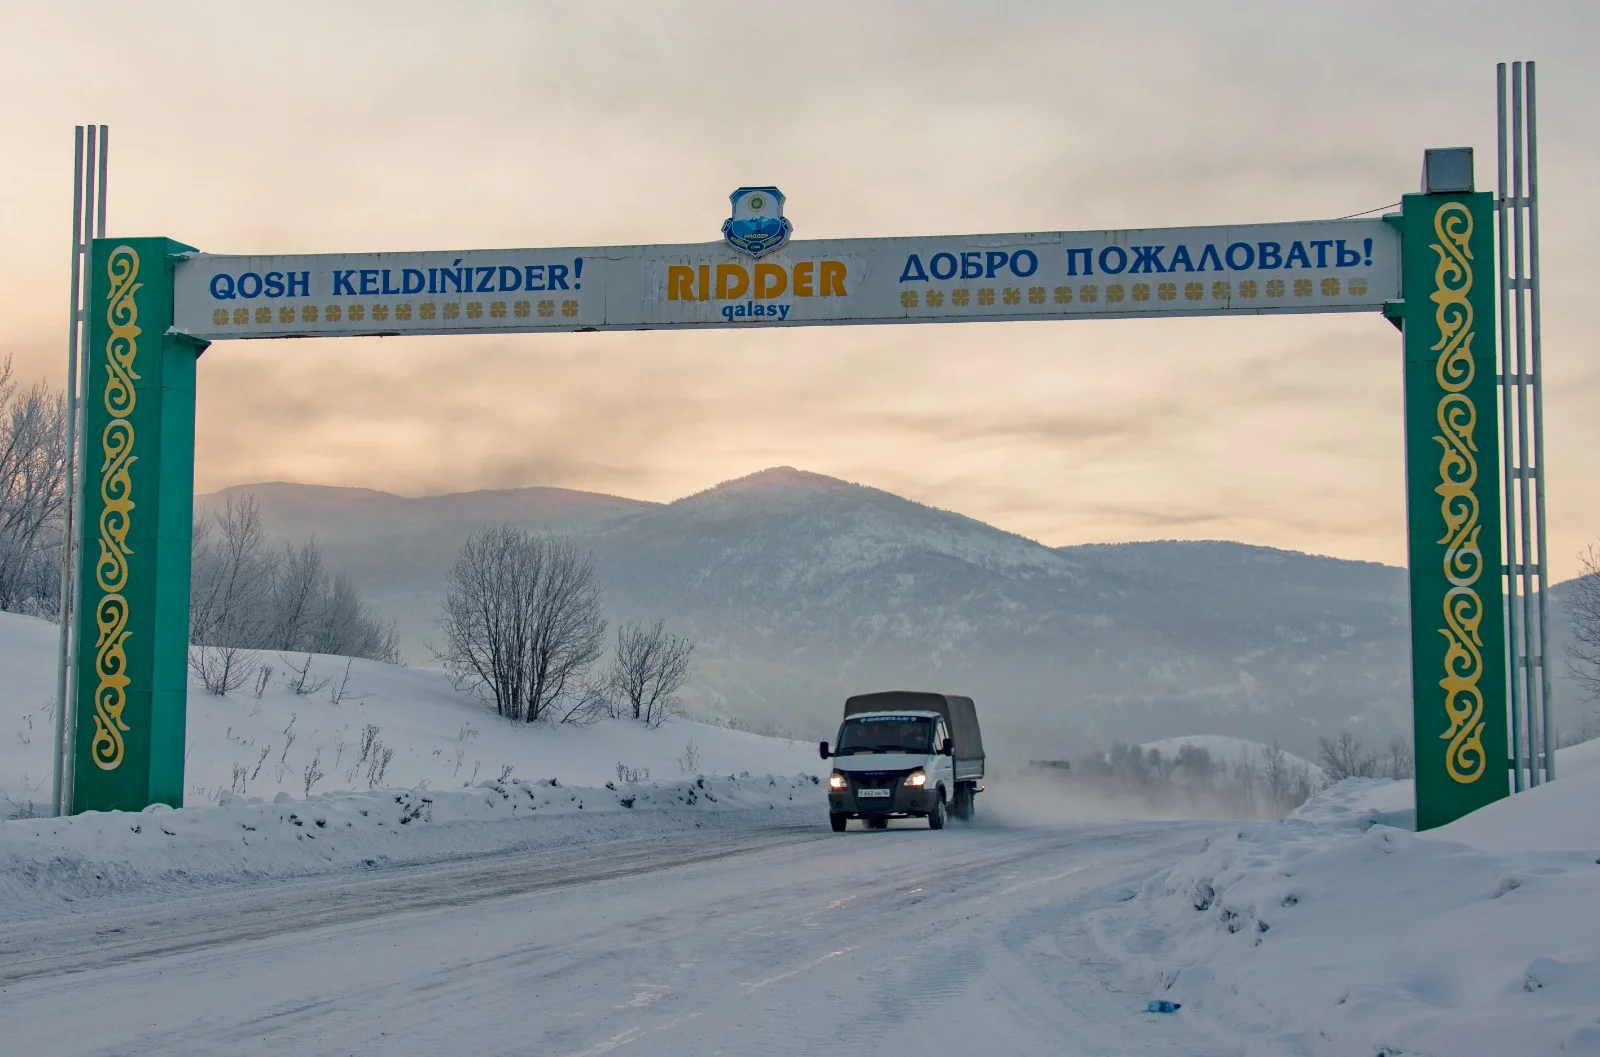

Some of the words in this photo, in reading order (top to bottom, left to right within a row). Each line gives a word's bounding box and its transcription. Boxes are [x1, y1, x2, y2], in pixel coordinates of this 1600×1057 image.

[209, 271, 310, 300] QOSH
[333, 257, 584, 296] KELDIŃIZDER!
[667, 261, 848, 301] RIDDER
[900, 249, 1039, 283] ДОБРО
[1066, 238, 1374, 277] ПОЖАЛОВАТЬ!
[721, 300, 791, 321] qalasy
